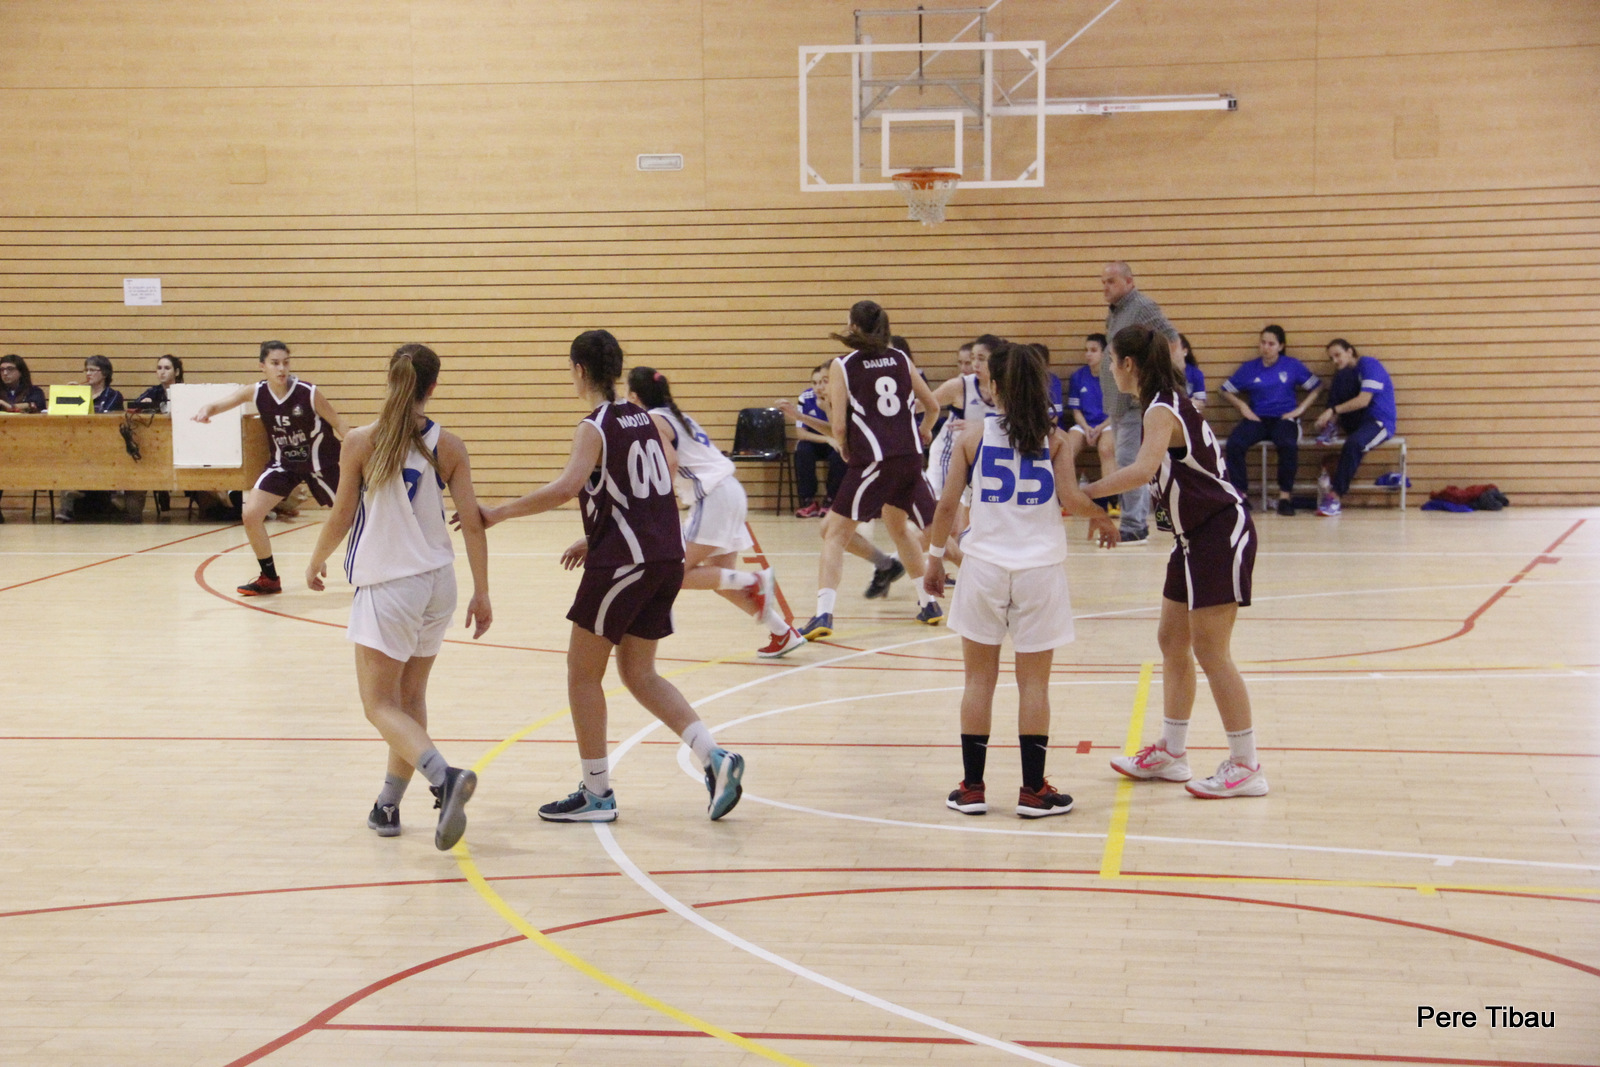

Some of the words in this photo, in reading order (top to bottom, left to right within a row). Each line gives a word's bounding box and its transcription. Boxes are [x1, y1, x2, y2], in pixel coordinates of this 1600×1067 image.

[863, 357, 898, 369] DAURA
[875, 376, 901, 417] 8
[275, 415, 292, 427] 15
[627, 438, 672, 499] 00
[981, 446, 1055, 506] 55
[1026, 497, 1040, 505] CBT
